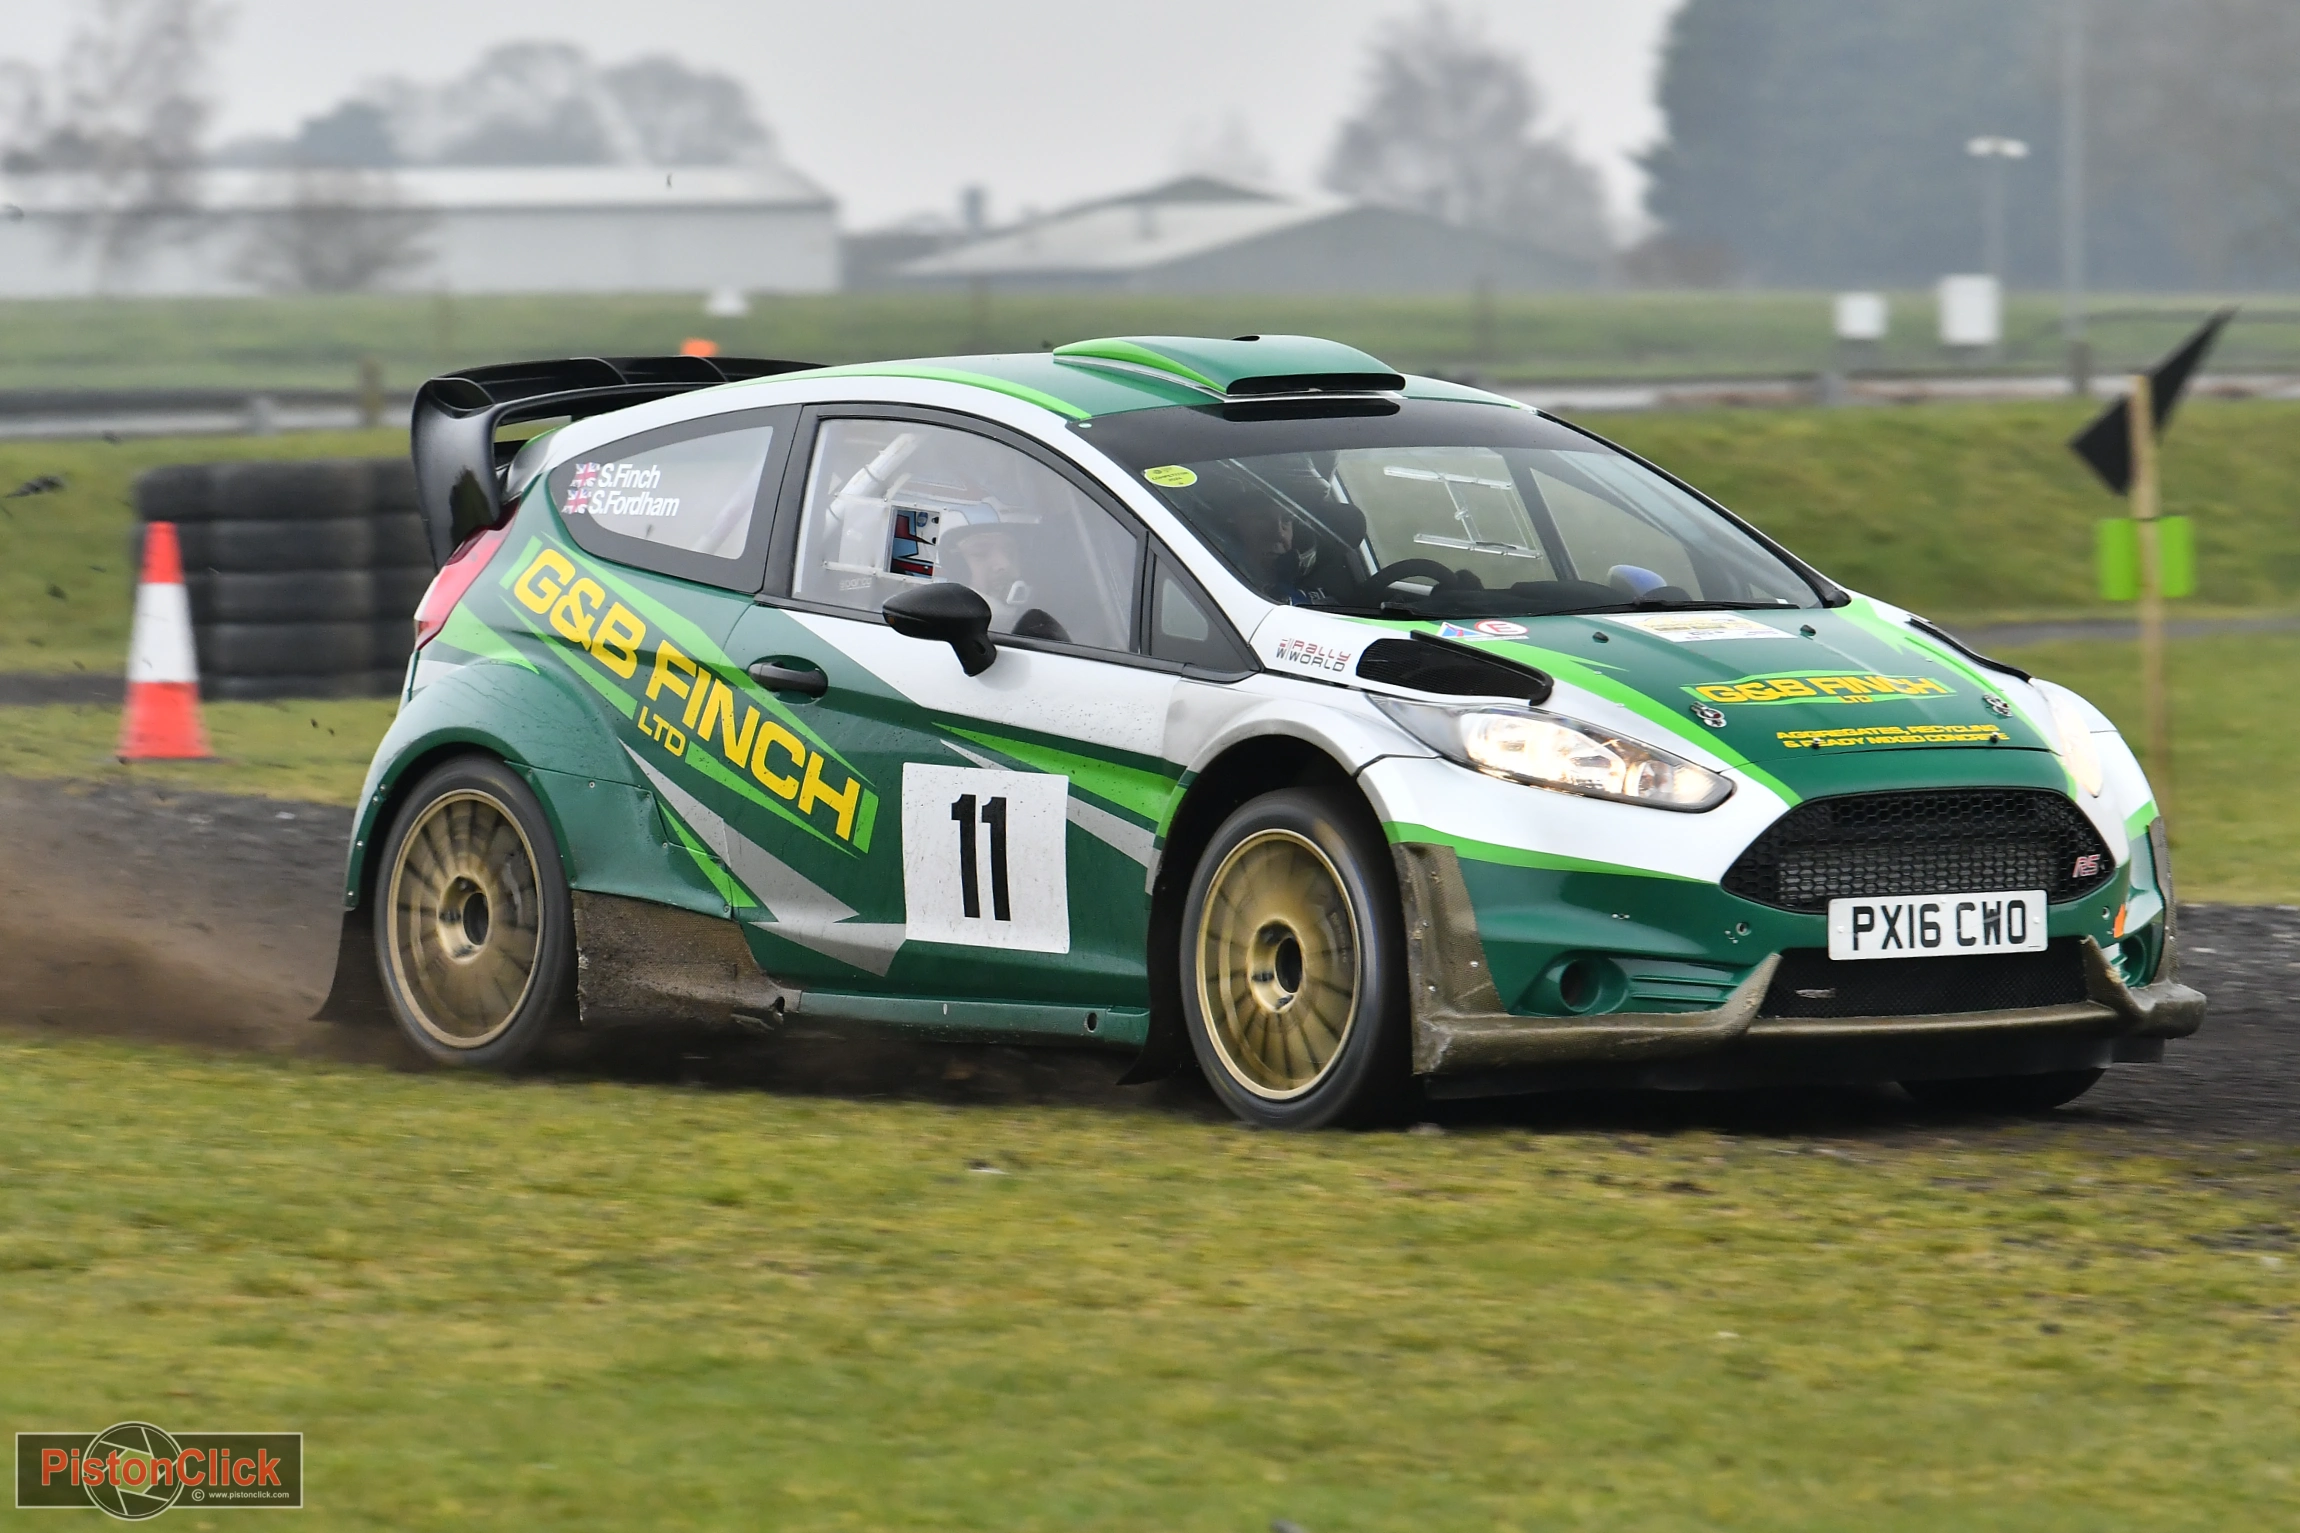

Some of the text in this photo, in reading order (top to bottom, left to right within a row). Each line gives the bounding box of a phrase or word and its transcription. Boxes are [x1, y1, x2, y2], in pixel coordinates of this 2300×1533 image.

[598, 463, 660, 488] S.Finch
[588, 490, 680, 516] S.Fordham
[1289, 650, 1346, 672] WORLD
[514, 549, 861, 841] G&B FINCH
[1696, 675, 1948, 702] G&B FINCH
[1839, 695, 1873, 703] LTD
[637, 706, 687, 757] LTD
[1868, 734, 1926, 744] MIXED
[1907, 724, 2000, 734] RECYCLING
[951, 794, 1011, 921] 11
[2072, 855, 2099, 878] RS
[1852, 900, 2026, 951] PX16 CWO
